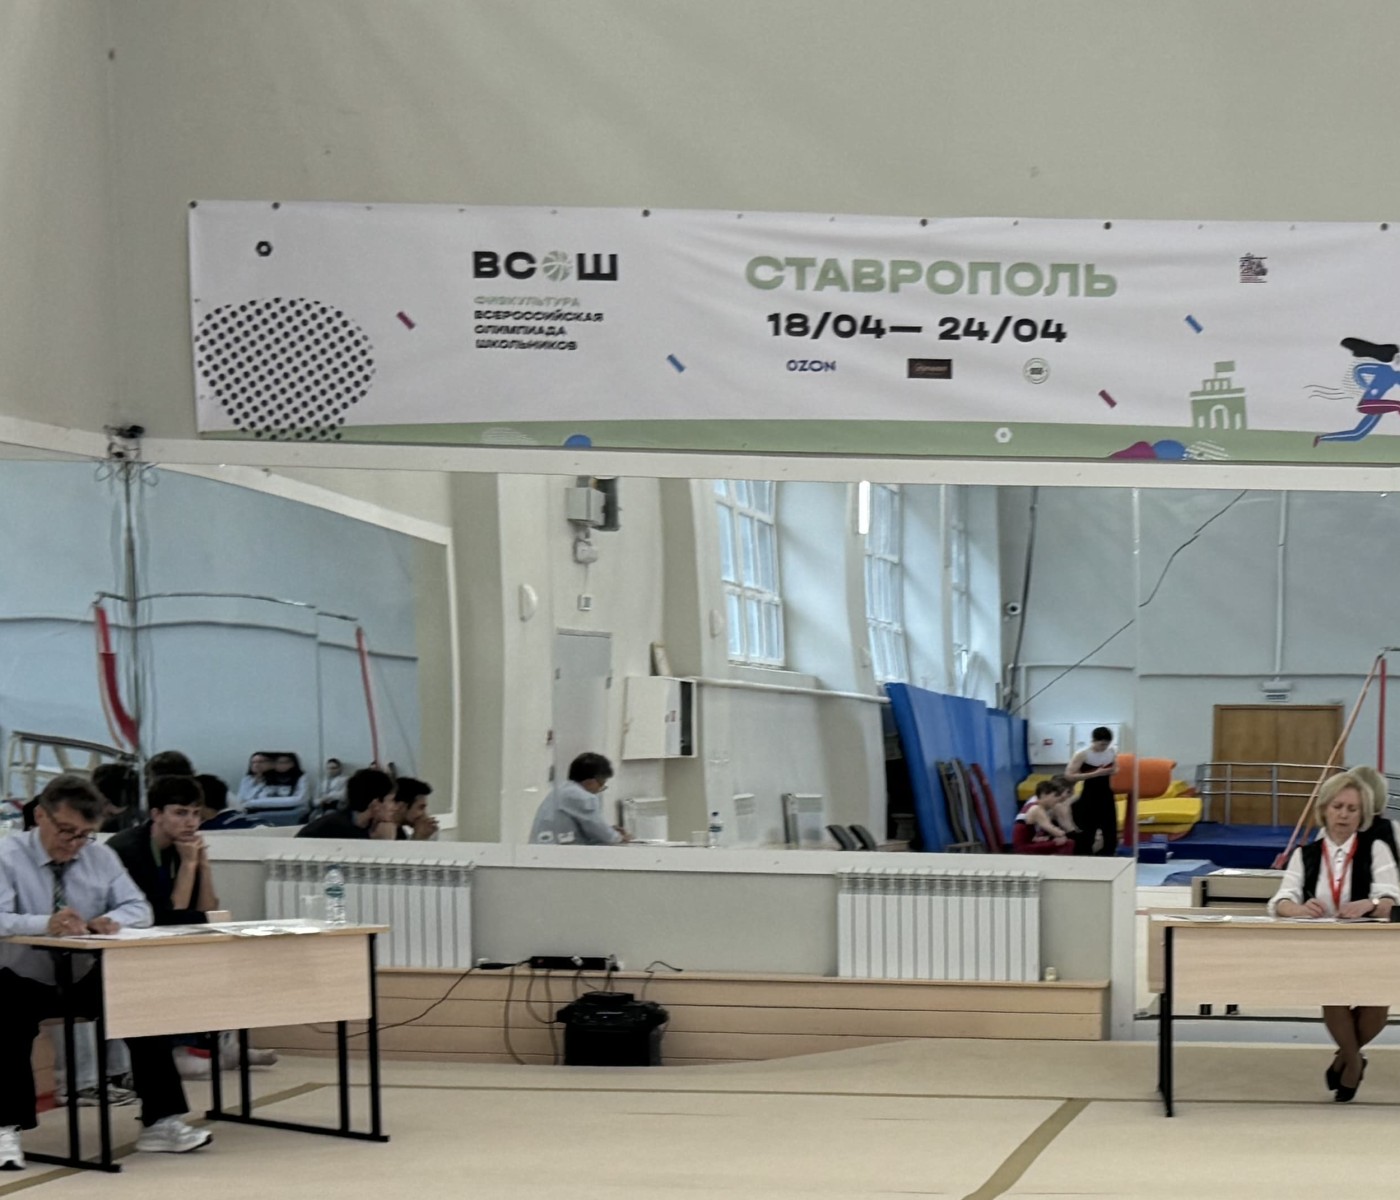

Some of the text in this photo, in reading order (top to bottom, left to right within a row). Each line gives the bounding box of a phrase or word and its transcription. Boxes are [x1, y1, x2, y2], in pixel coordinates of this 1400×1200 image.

[745, 255, 1118, 298] СТАВРОПОЛЬ
[474, 309, 604, 322] ВСЕРОССИЙСКАЯ
[474, 325, 567, 336] ОЛИМПИАДА
[938, 315, 1068, 344] 24/04
[475, 339, 578, 351] ШКОЛЬНИКОВ
[786, 359, 837, 372] OZON
